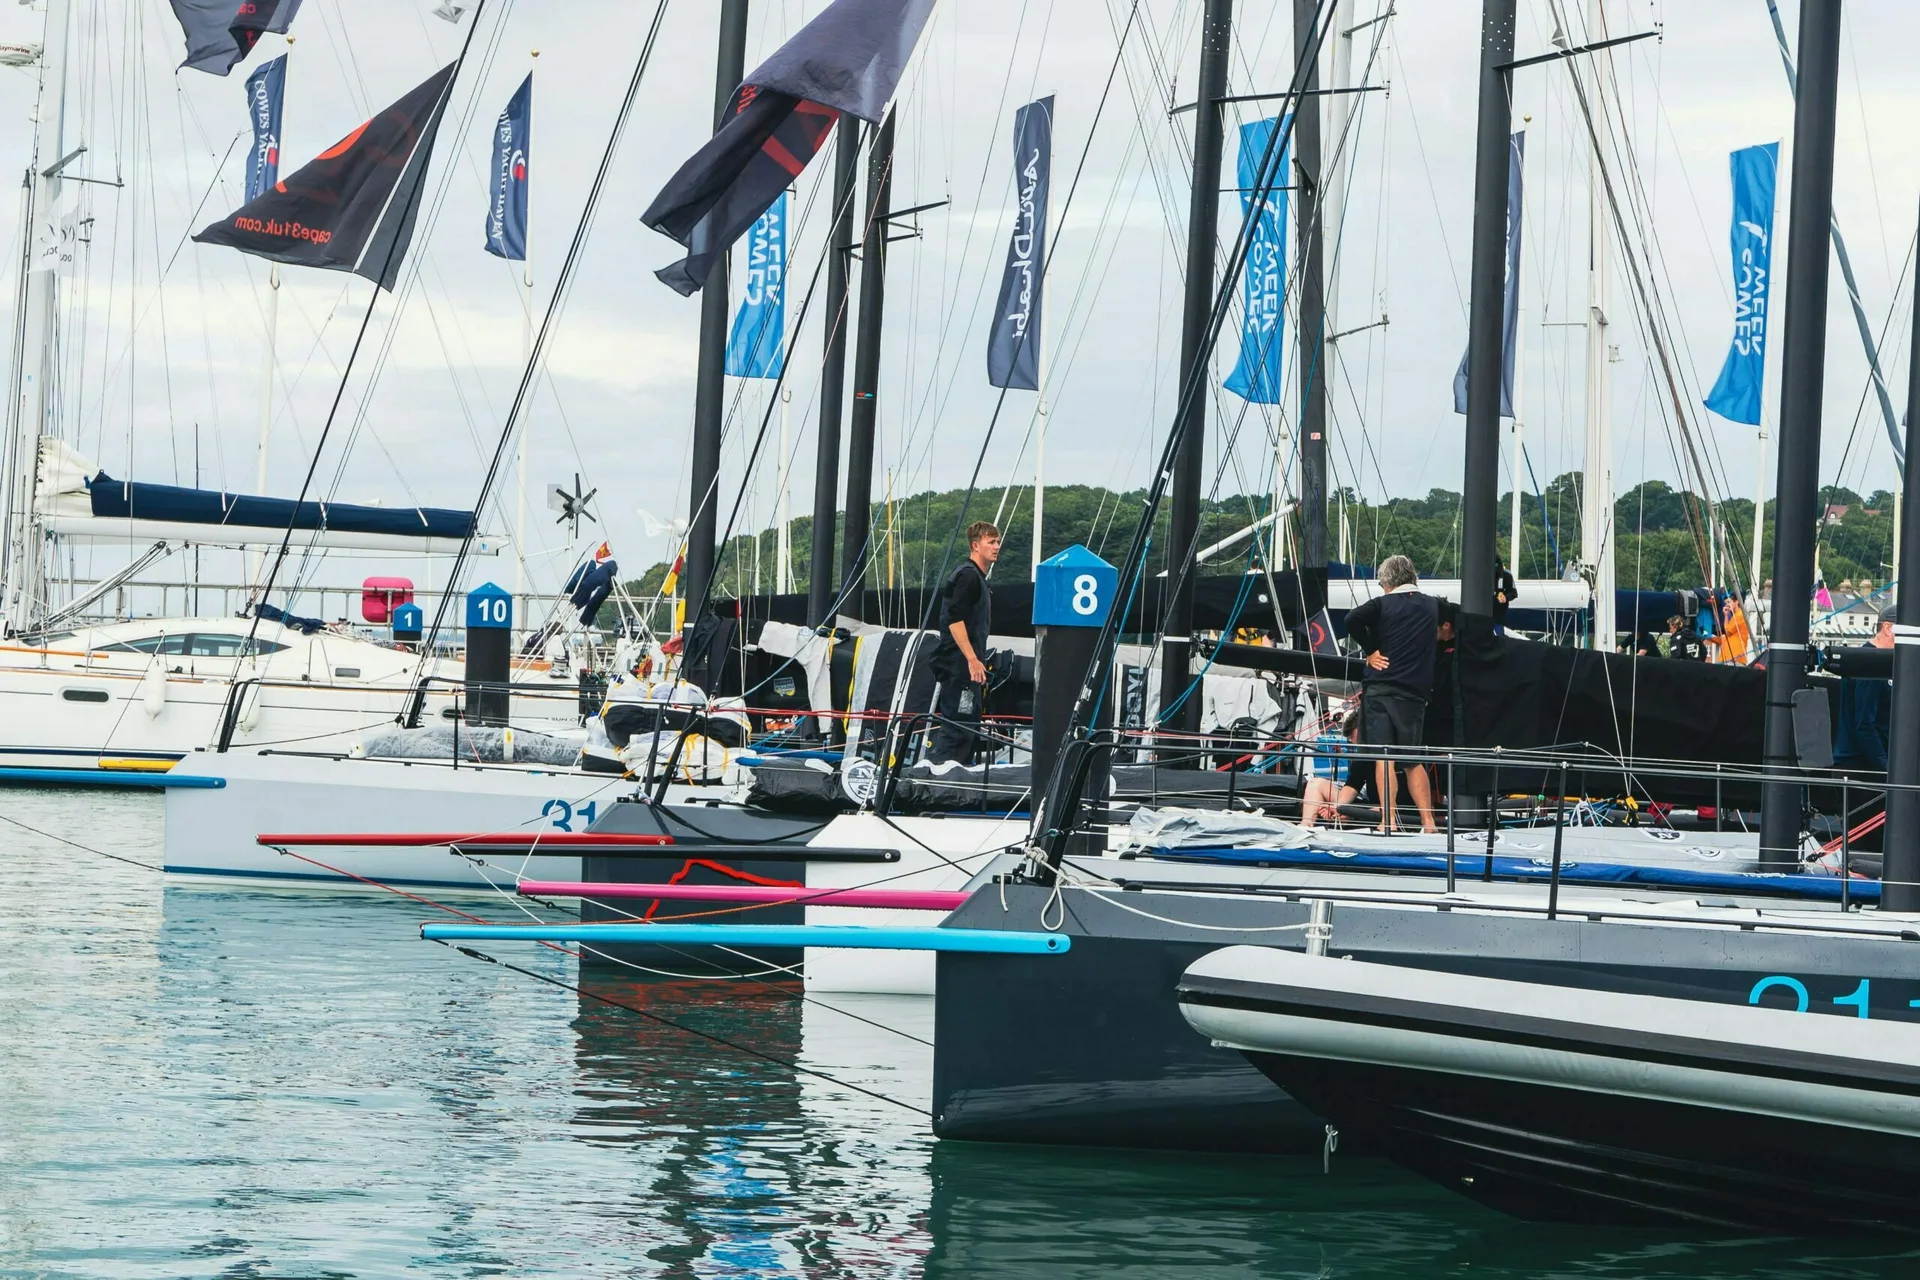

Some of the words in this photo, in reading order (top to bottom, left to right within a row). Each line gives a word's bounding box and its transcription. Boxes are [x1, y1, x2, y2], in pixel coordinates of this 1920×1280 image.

[254, 80, 270, 129] COWES
[478, 598, 507, 623] 10
[1072, 574, 1098, 616] 8
[404, 612, 412, 627] 1
